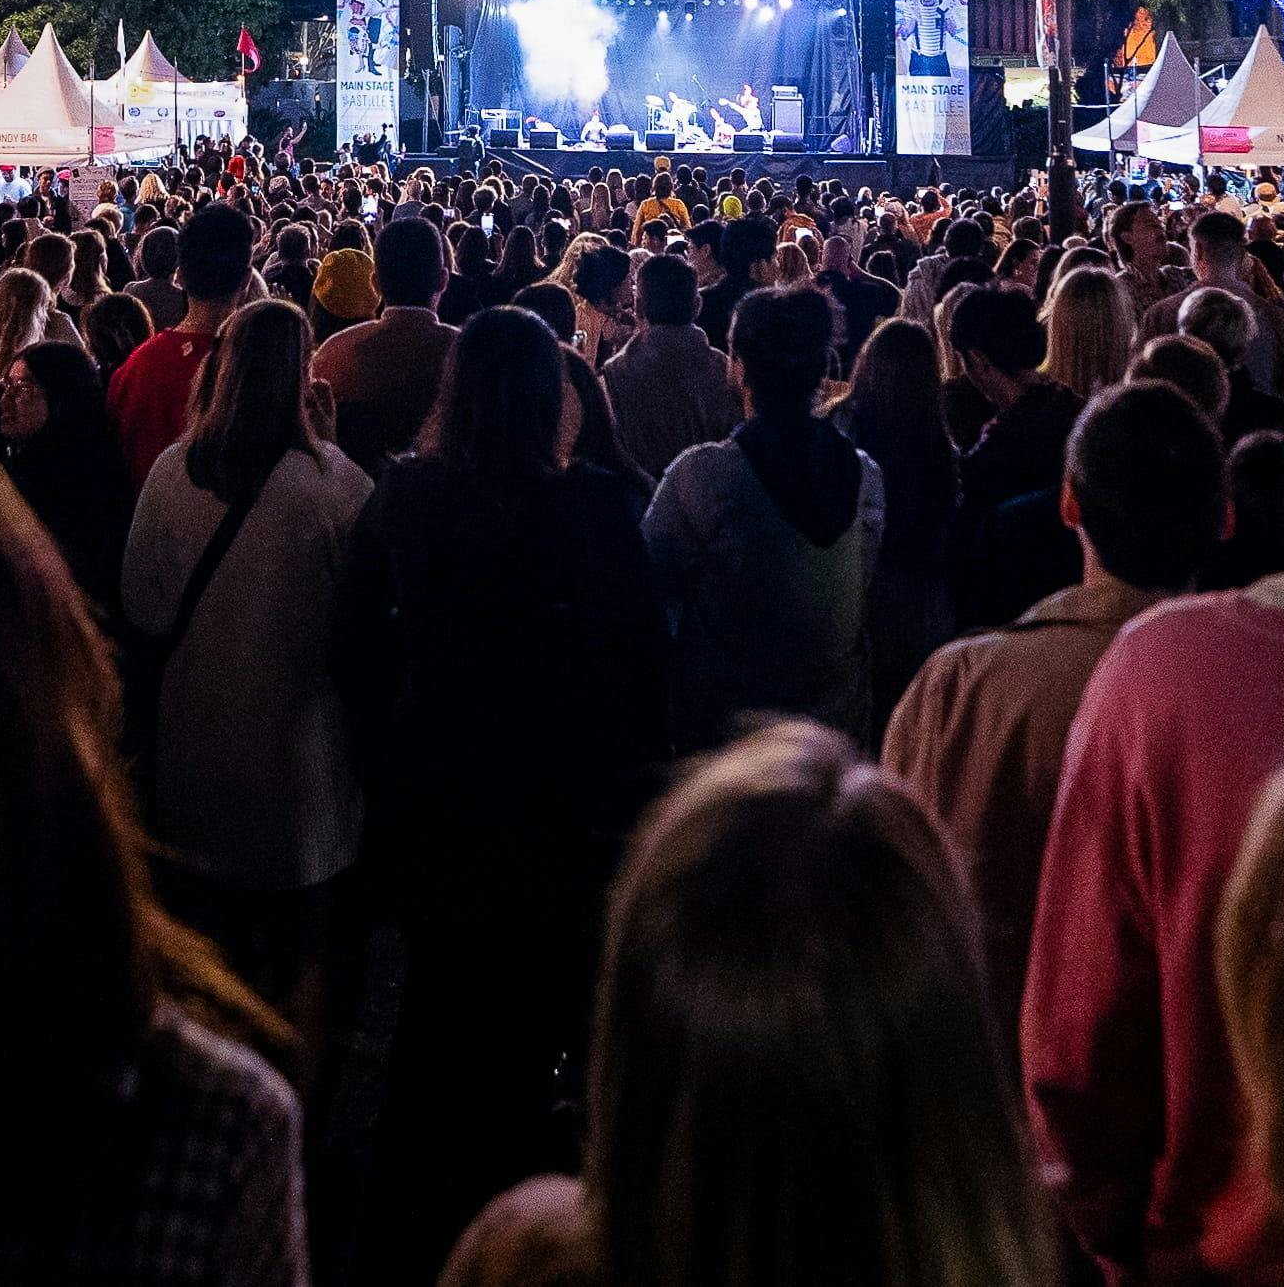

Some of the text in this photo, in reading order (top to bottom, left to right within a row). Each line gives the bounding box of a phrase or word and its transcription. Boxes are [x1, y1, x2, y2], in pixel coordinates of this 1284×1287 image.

[340, 81, 395, 92] MAIN STAGE
[901, 84, 965, 96] MAIN STAGE
[19, 133, 38, 144] BAR
